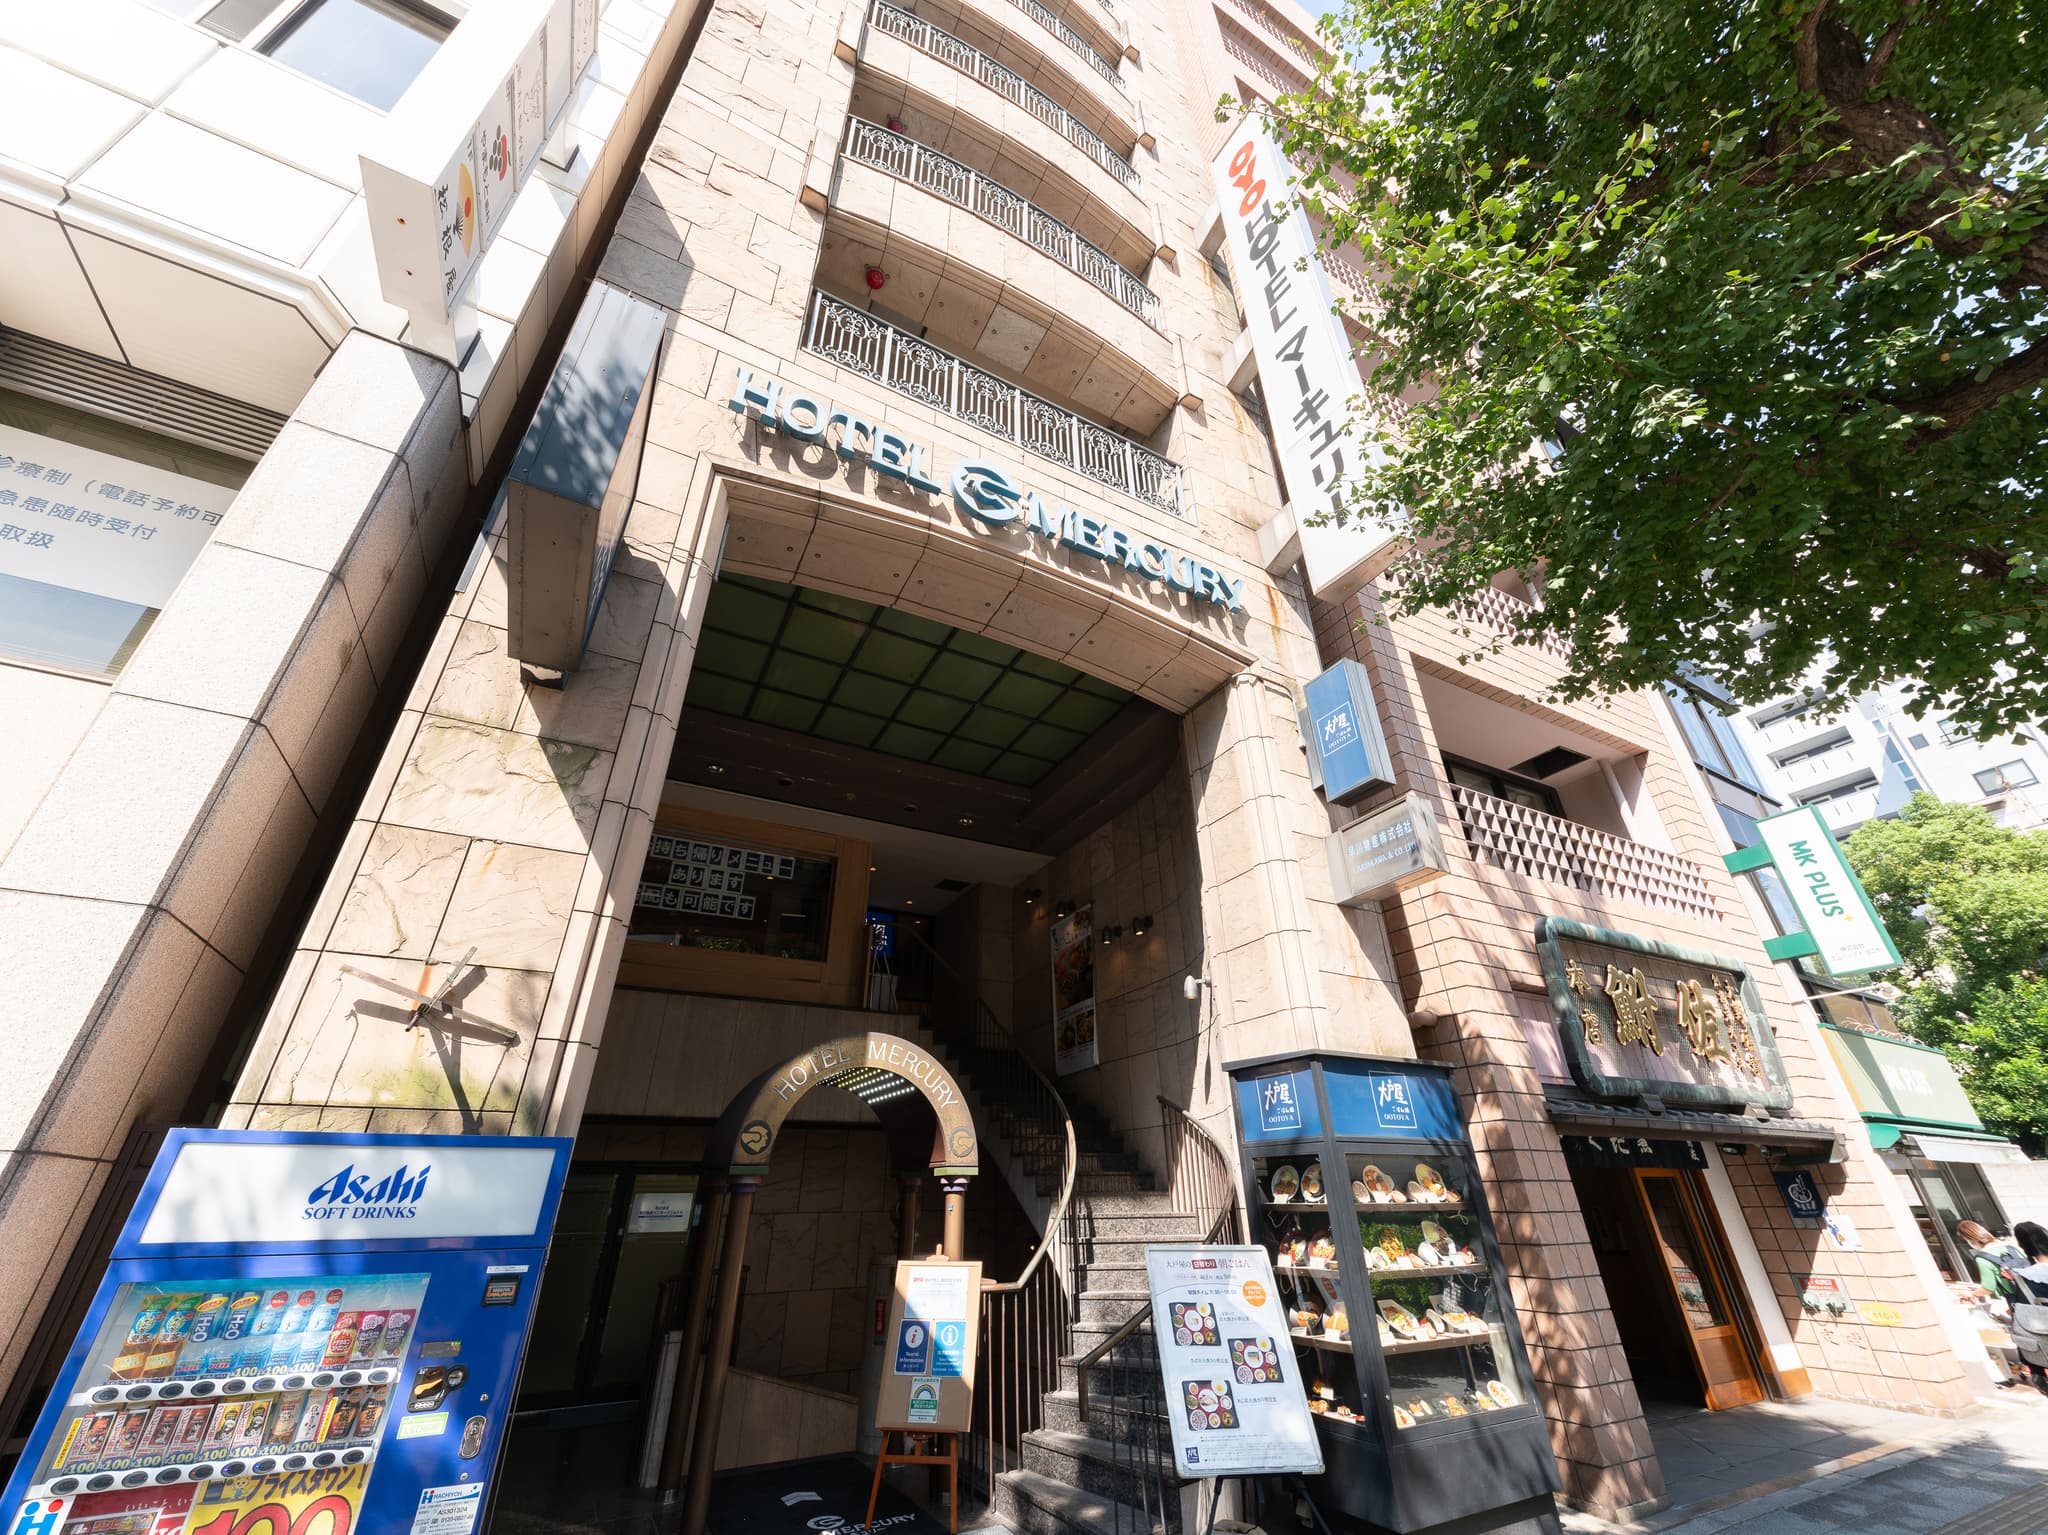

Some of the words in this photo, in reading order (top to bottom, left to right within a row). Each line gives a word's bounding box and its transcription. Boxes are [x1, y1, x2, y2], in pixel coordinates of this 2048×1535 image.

[1228, 140, 1267, 218] OYO
[1246, 199, 1297, 333] HOTEL
[1275, 325, 1346, 530] マーキュリー
[728, 367, 941, 495] HOTEL
[1027, 491, 1245, 614] MERCURY
[672, 867, 742, 889] あります
[1788, 840, 1817, 867] MK
[1804, 871, 1844, 918] PLUS
[774, 1041, 851, 1102] HOTEL
[868, 1040, 959, 1108] MERCURY
[1265, 1079, 1294, 1111] 大戸屋
[1378, 1079, 1408, 1107] 大戸屋
[1268, 1114, 1295, 1123] OOTOYA
[1384, 1113, 1410, 1121] OOTOYA
[308, 1164, 432, 1206] Asahi
[302, 1207, 349, 1220] SOFT
[352, 1206, 416, 1220] DRINKS
[193, 1316, 212, 1342] H2O
[225, 1314, 246, 1340] H2O
